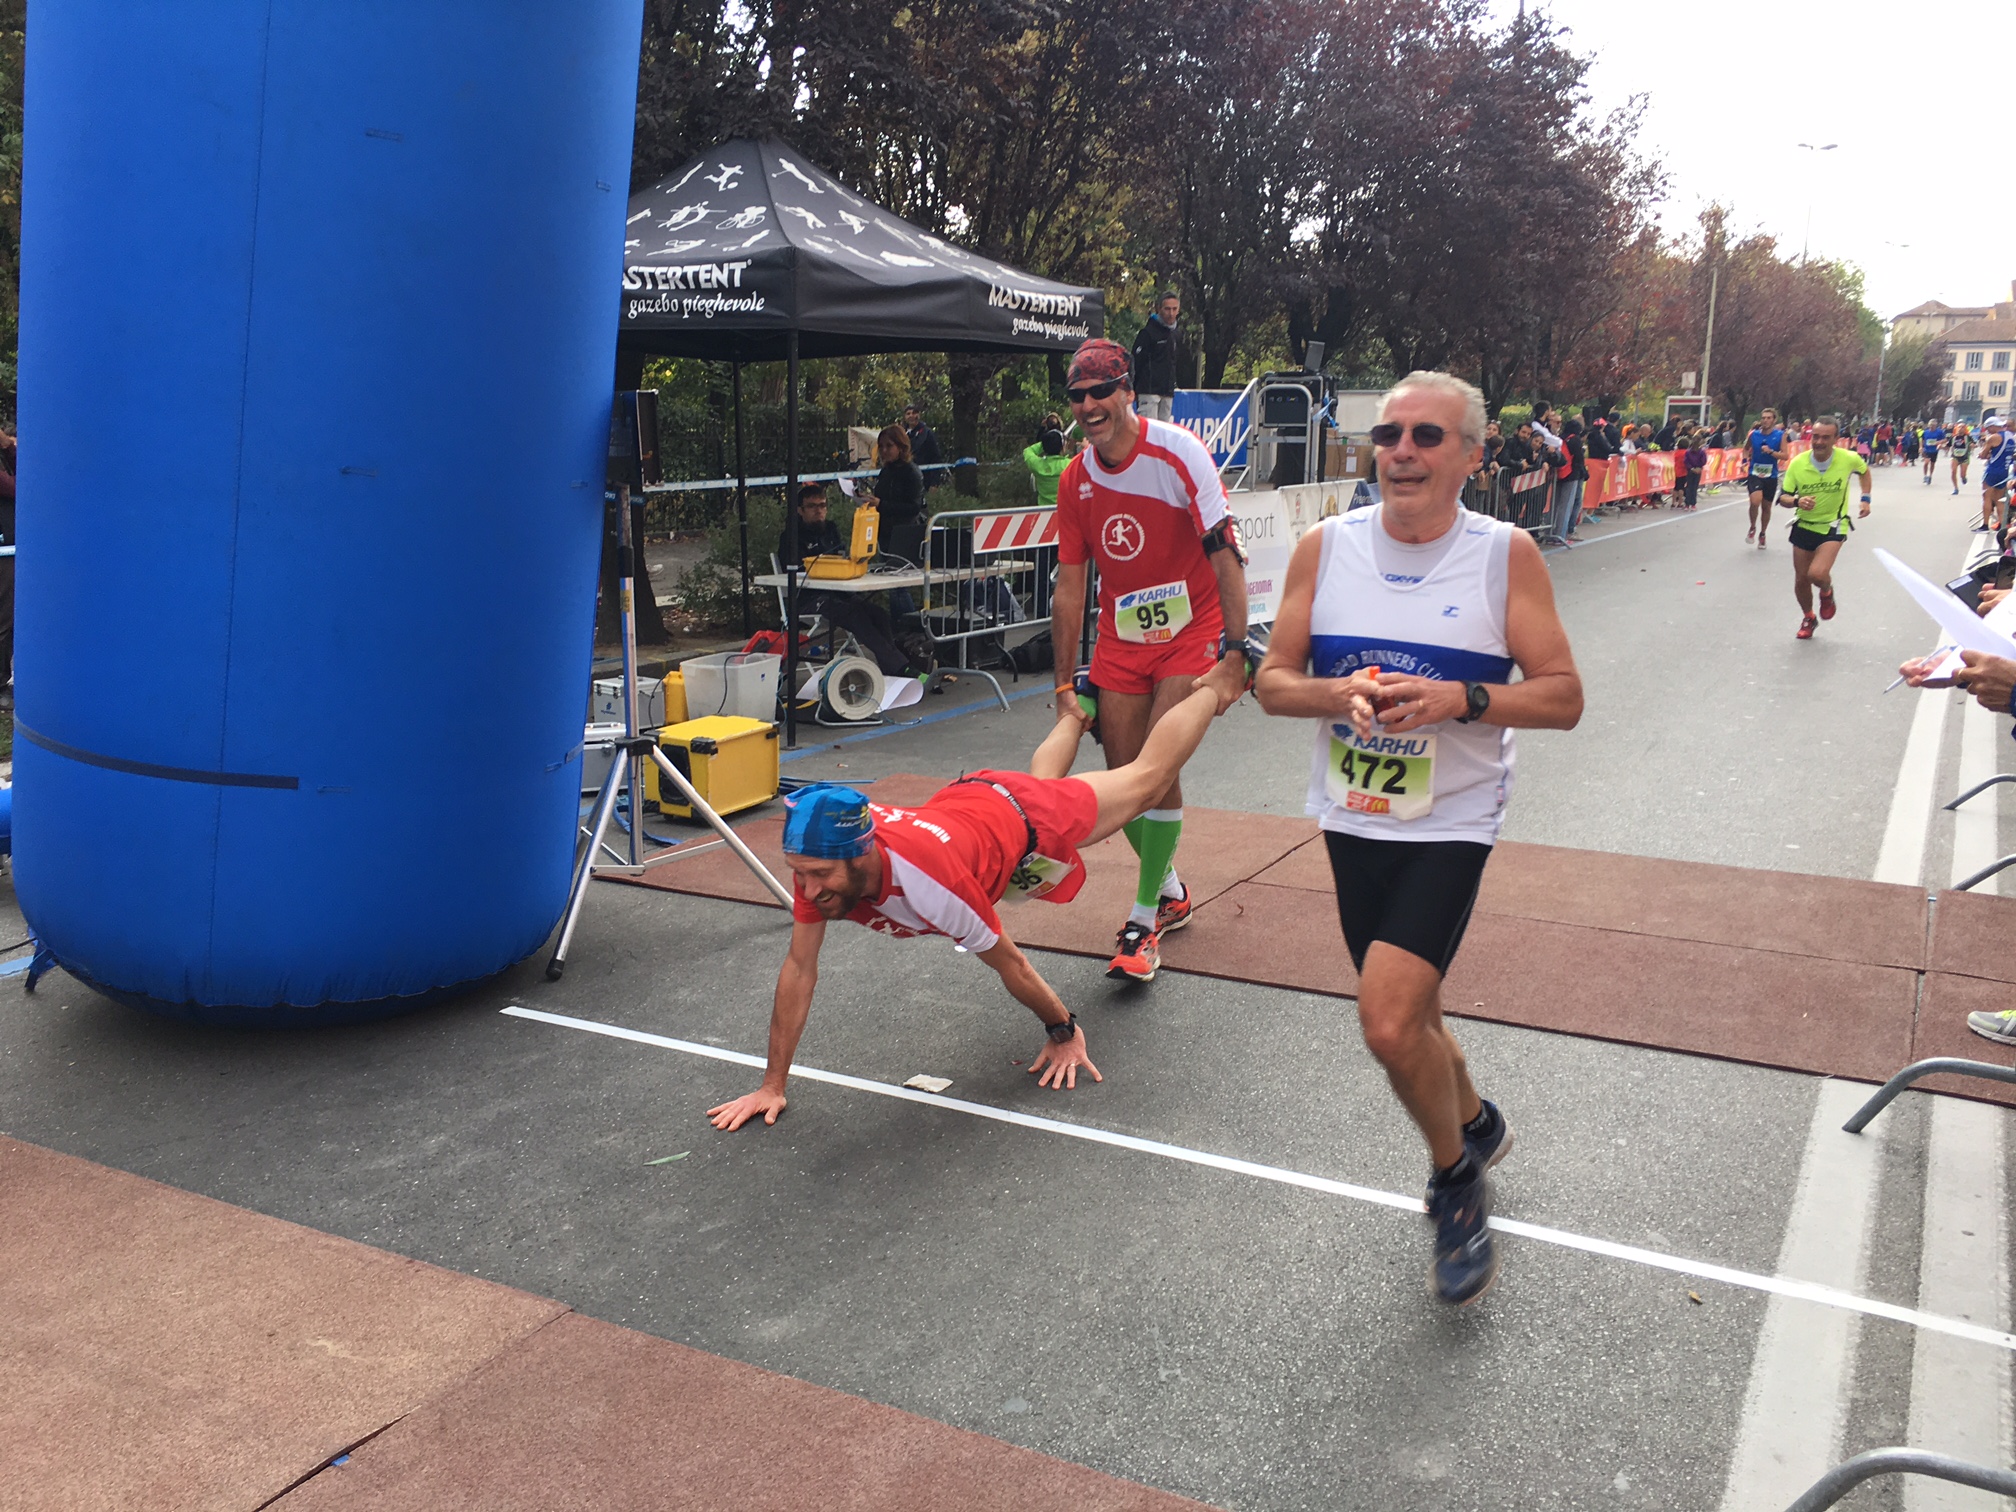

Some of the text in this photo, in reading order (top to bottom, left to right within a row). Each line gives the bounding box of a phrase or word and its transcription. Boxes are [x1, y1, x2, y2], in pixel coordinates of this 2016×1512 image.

[627, 290, 766, 319] gazebo pieghevole
[988, 283, 1083, 317] MASTERTENT
[1011, 315, 1090, 341] gazebo pieghevole
[1178, 417, 1243, 454] ARHU
[1138, 585, 1182, 604] KARHU
[1136, 601, 1169, 630] 95
[1360, 649, 1418, 671] RUNNERS
[1353, 735, 1428, 756] KARHU
[1341, 749, 1407, 795] 472
